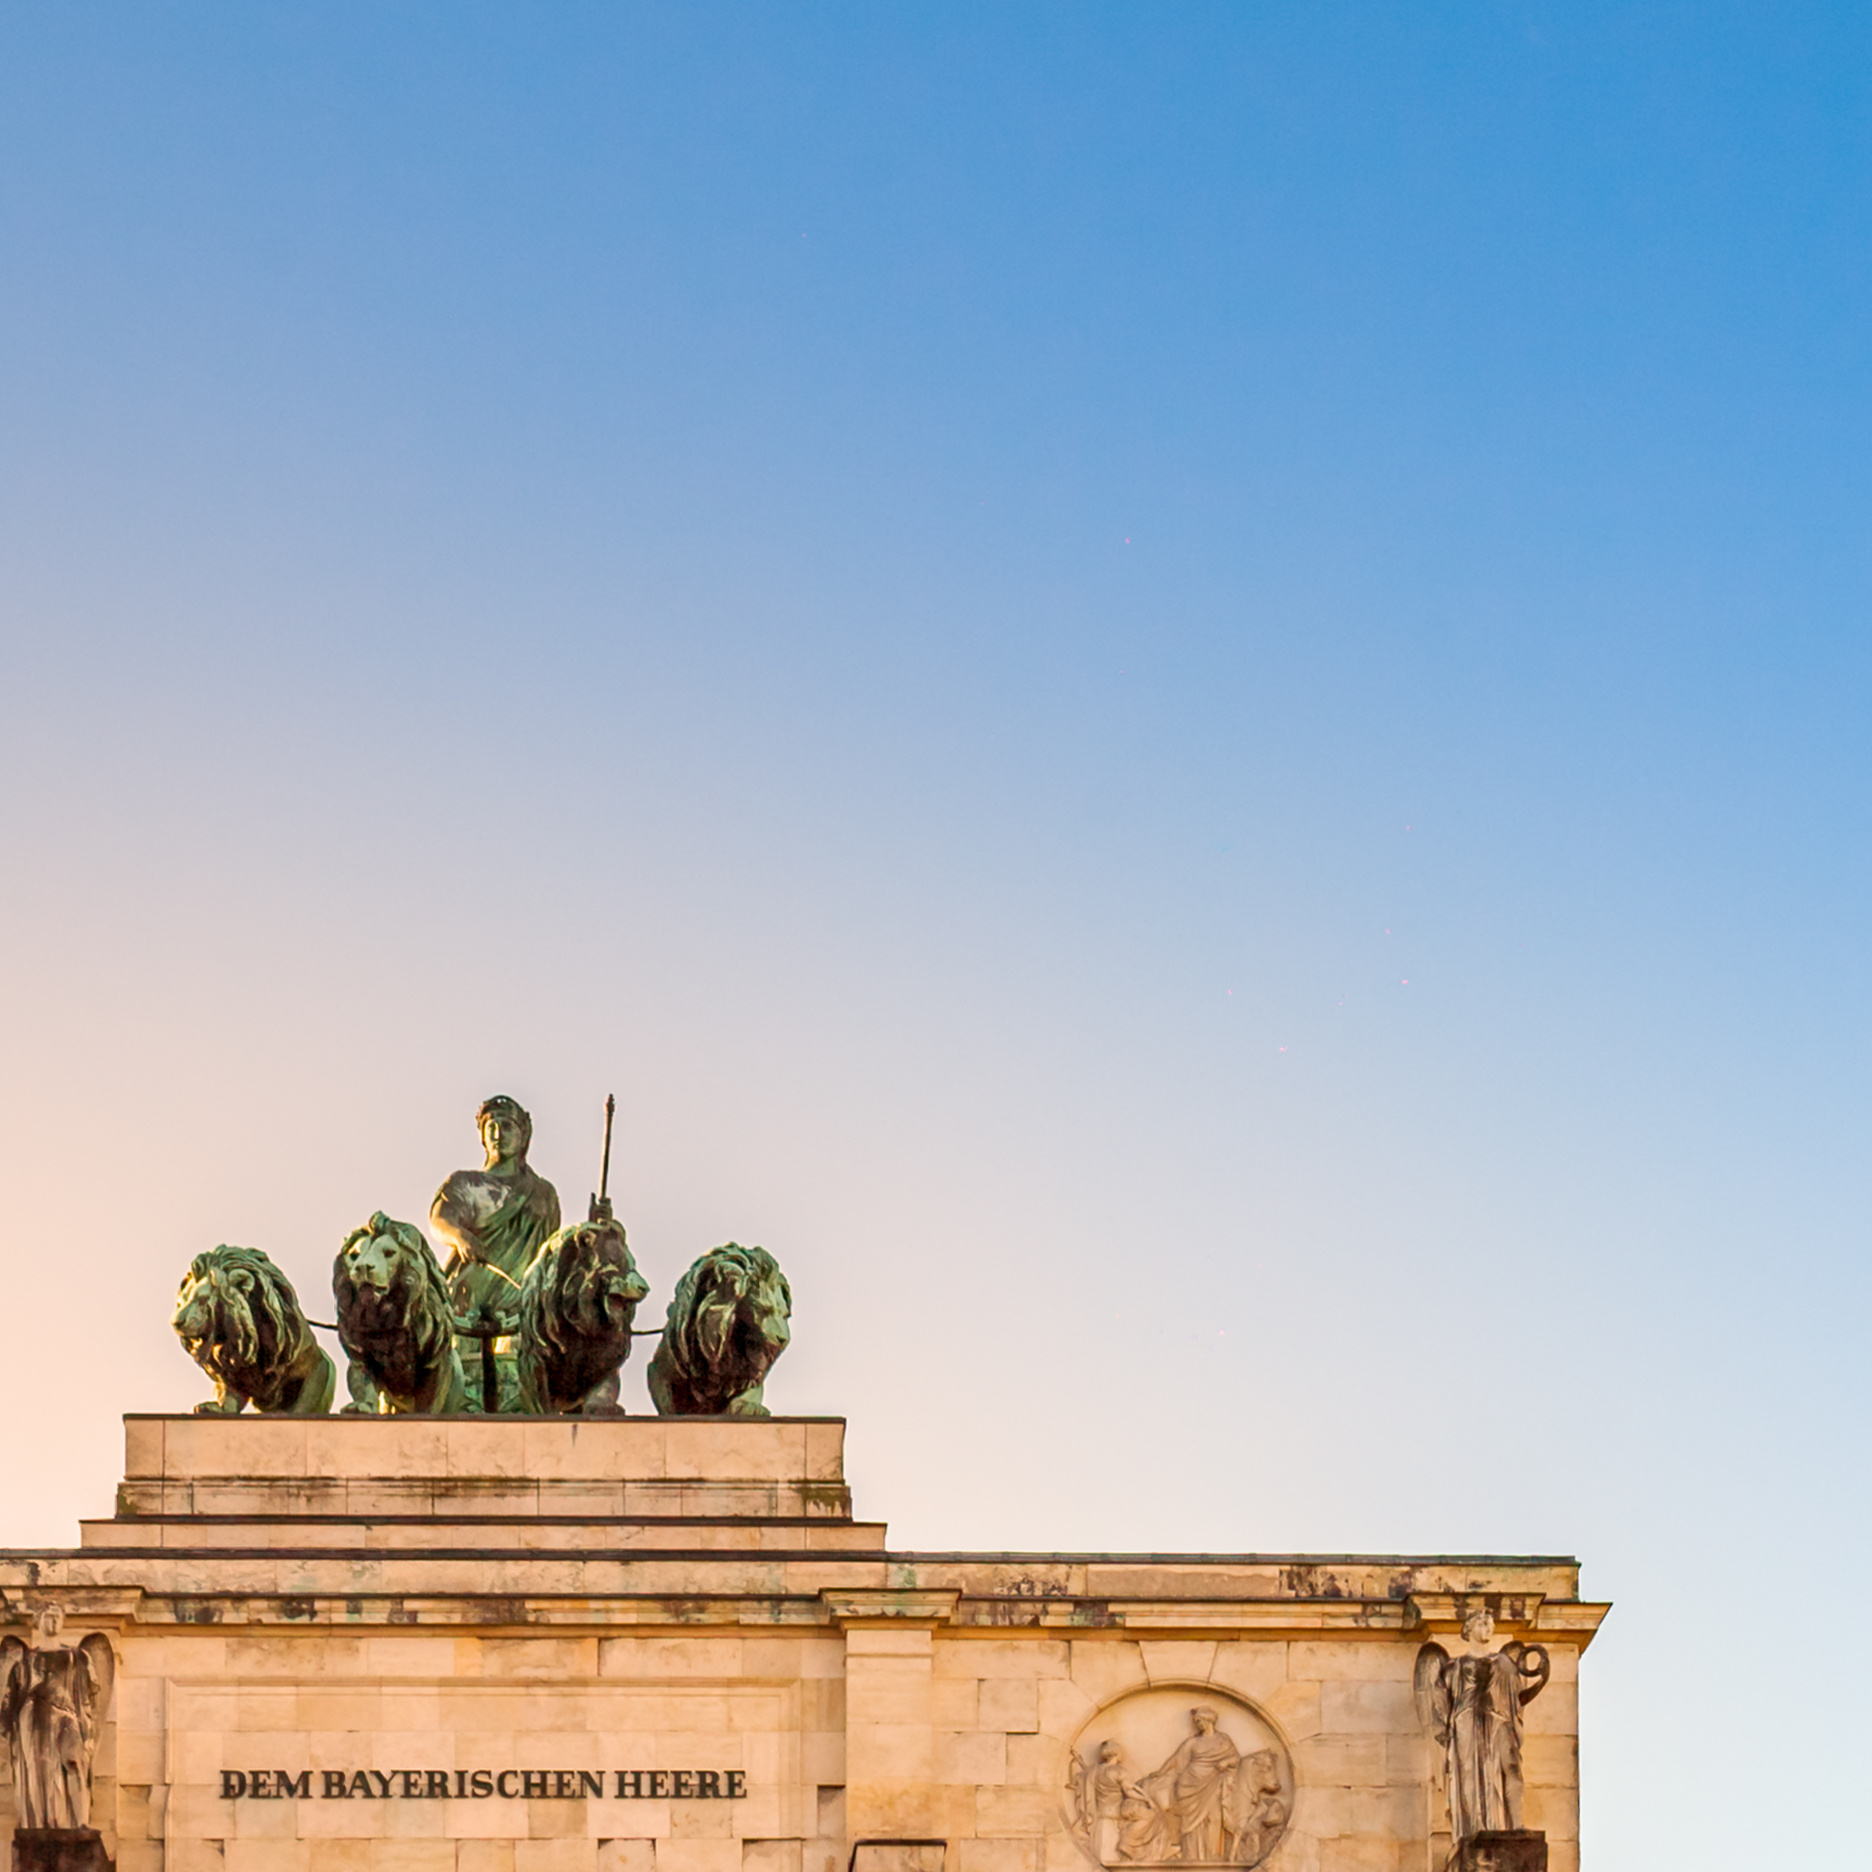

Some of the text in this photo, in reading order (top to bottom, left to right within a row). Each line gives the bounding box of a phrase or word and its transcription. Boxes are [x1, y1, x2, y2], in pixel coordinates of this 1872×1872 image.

[219, 1769, 748, 1800] DEM BAYERISCHEN HEERE
